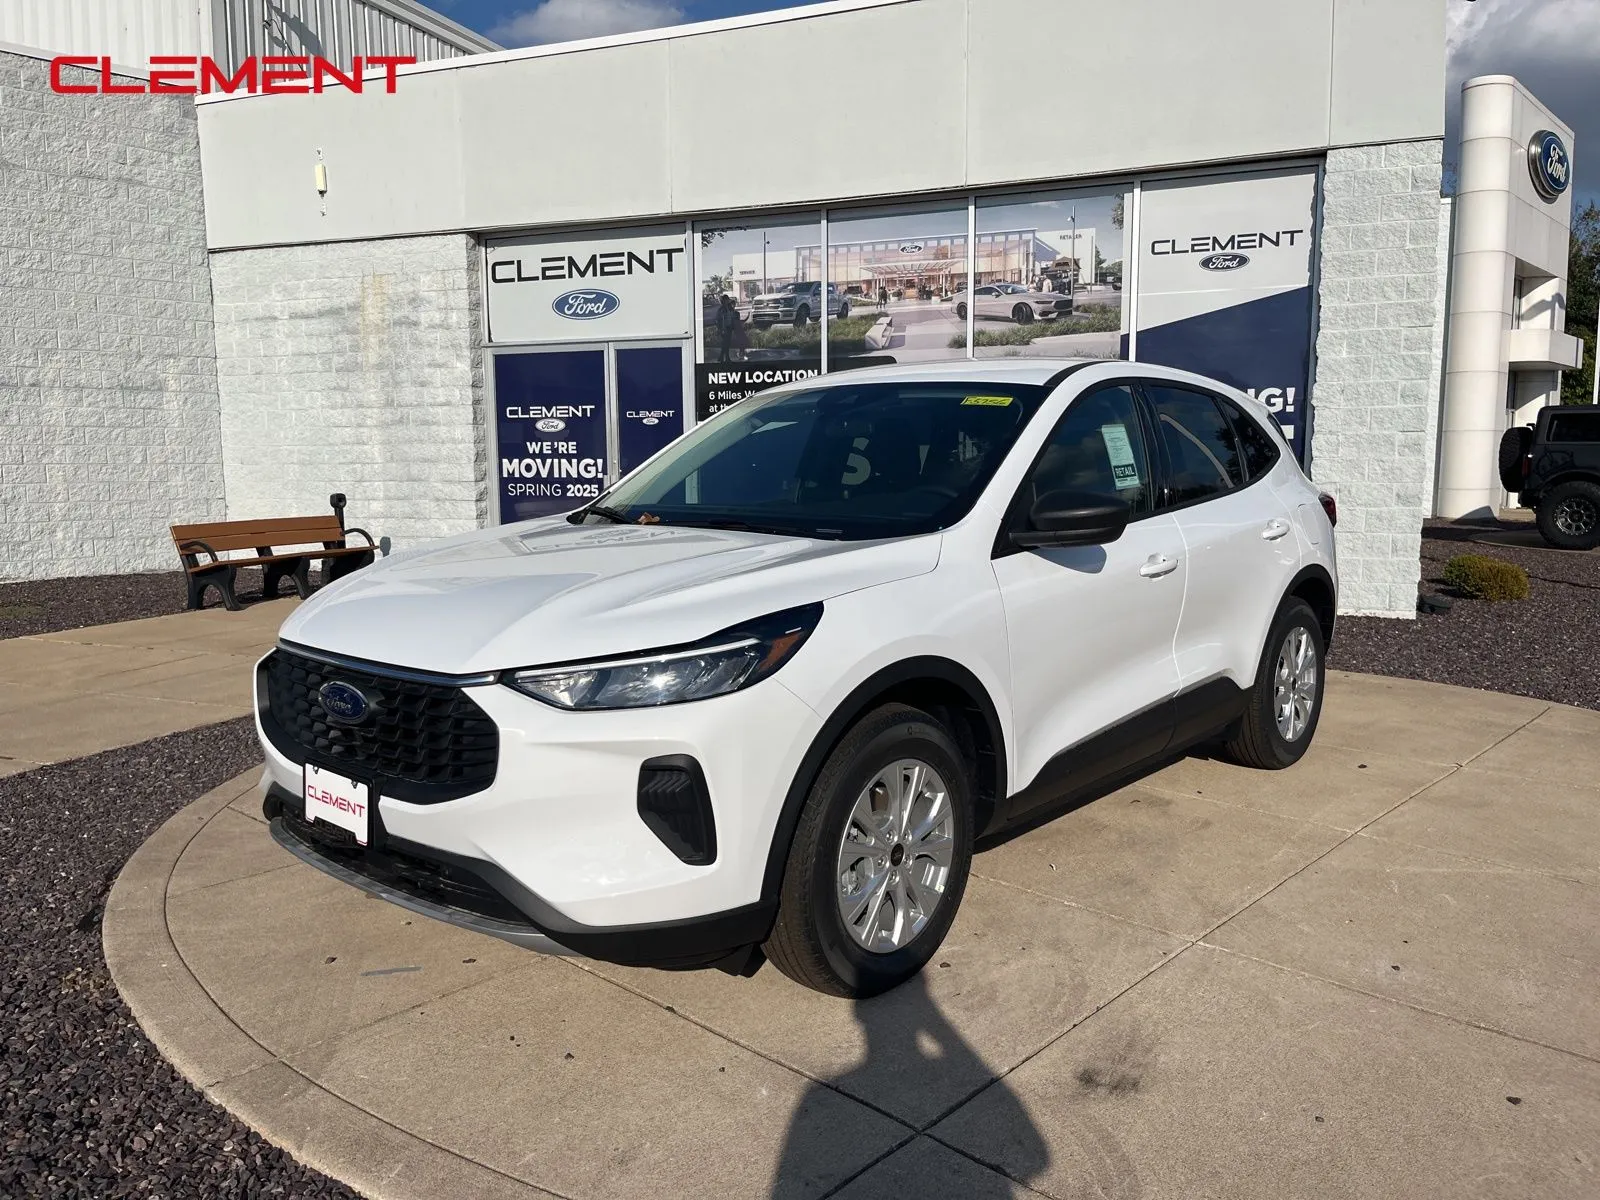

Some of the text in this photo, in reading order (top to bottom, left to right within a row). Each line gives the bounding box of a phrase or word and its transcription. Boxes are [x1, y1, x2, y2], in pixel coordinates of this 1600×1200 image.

[1547, 143, 1568, 183] Ford
[1151, 229, 1304, 255] CLEMENT
[491, 247, 684, 284] CLEMENT
[1208, 255, 1240, 269] Ford
[564, 293, 607, 316] Ford
[708, 369, 818, 384] NEW LOCATION
[708, 391, 716, 400] 6
[718, 390, 742, 400] Miles
[506, 405, 595, 418] CLEMENT
[626, 410, 675, 418] CLEMENT
[709, 404, 719, 413] at
[526, 441, 577, 454] WE'RE
[502, 458, 604, 479] MOVING!
[1114, 466, 1135, 478] RETAIL
[507, 483, 599, 497] SPRING 2025
[307, 784, 366, 818] CLEMENT
